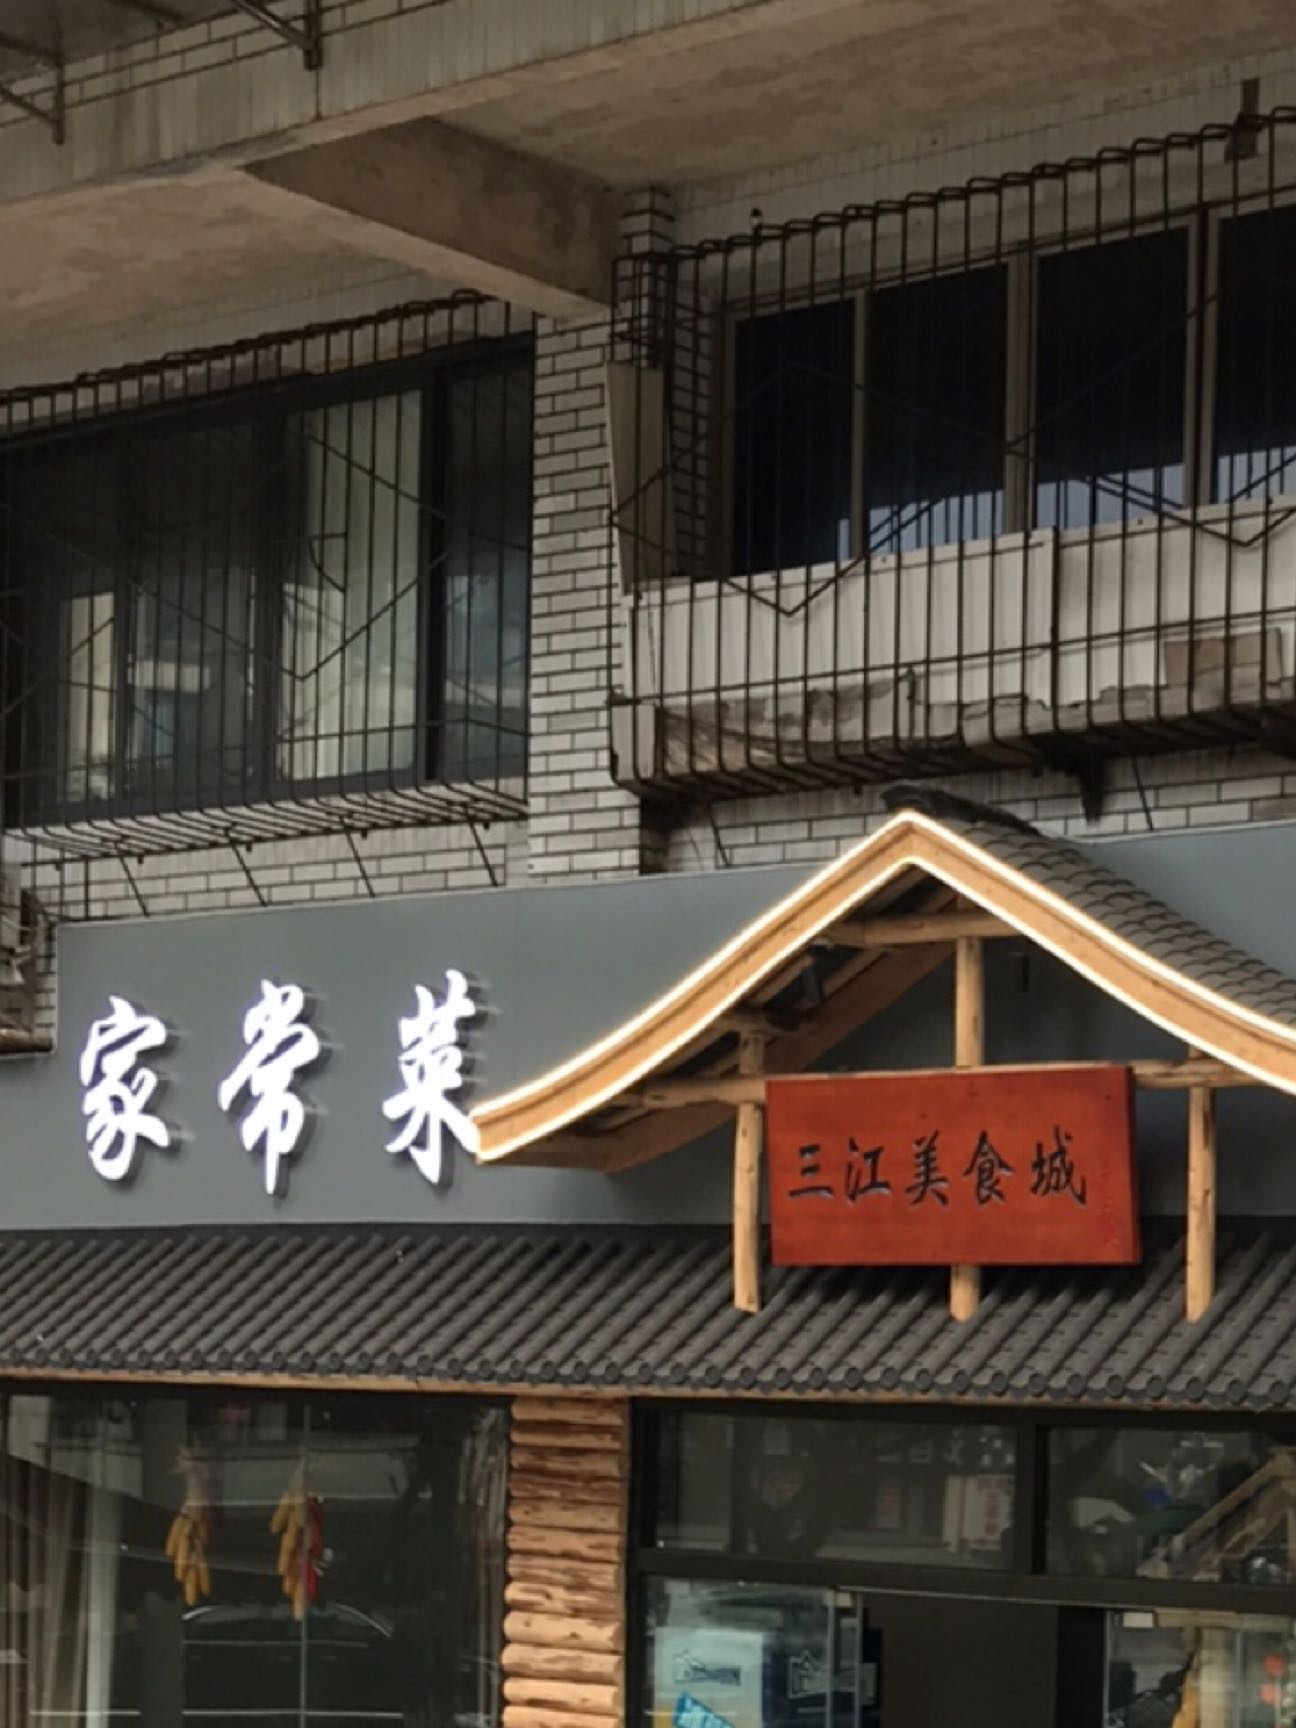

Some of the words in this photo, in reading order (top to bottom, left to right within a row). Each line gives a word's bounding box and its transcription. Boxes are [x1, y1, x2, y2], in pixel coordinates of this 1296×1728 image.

[80, 969, 482, 1195] 家常菜
[789, 1126, 1088, 1206] 三江美食城
